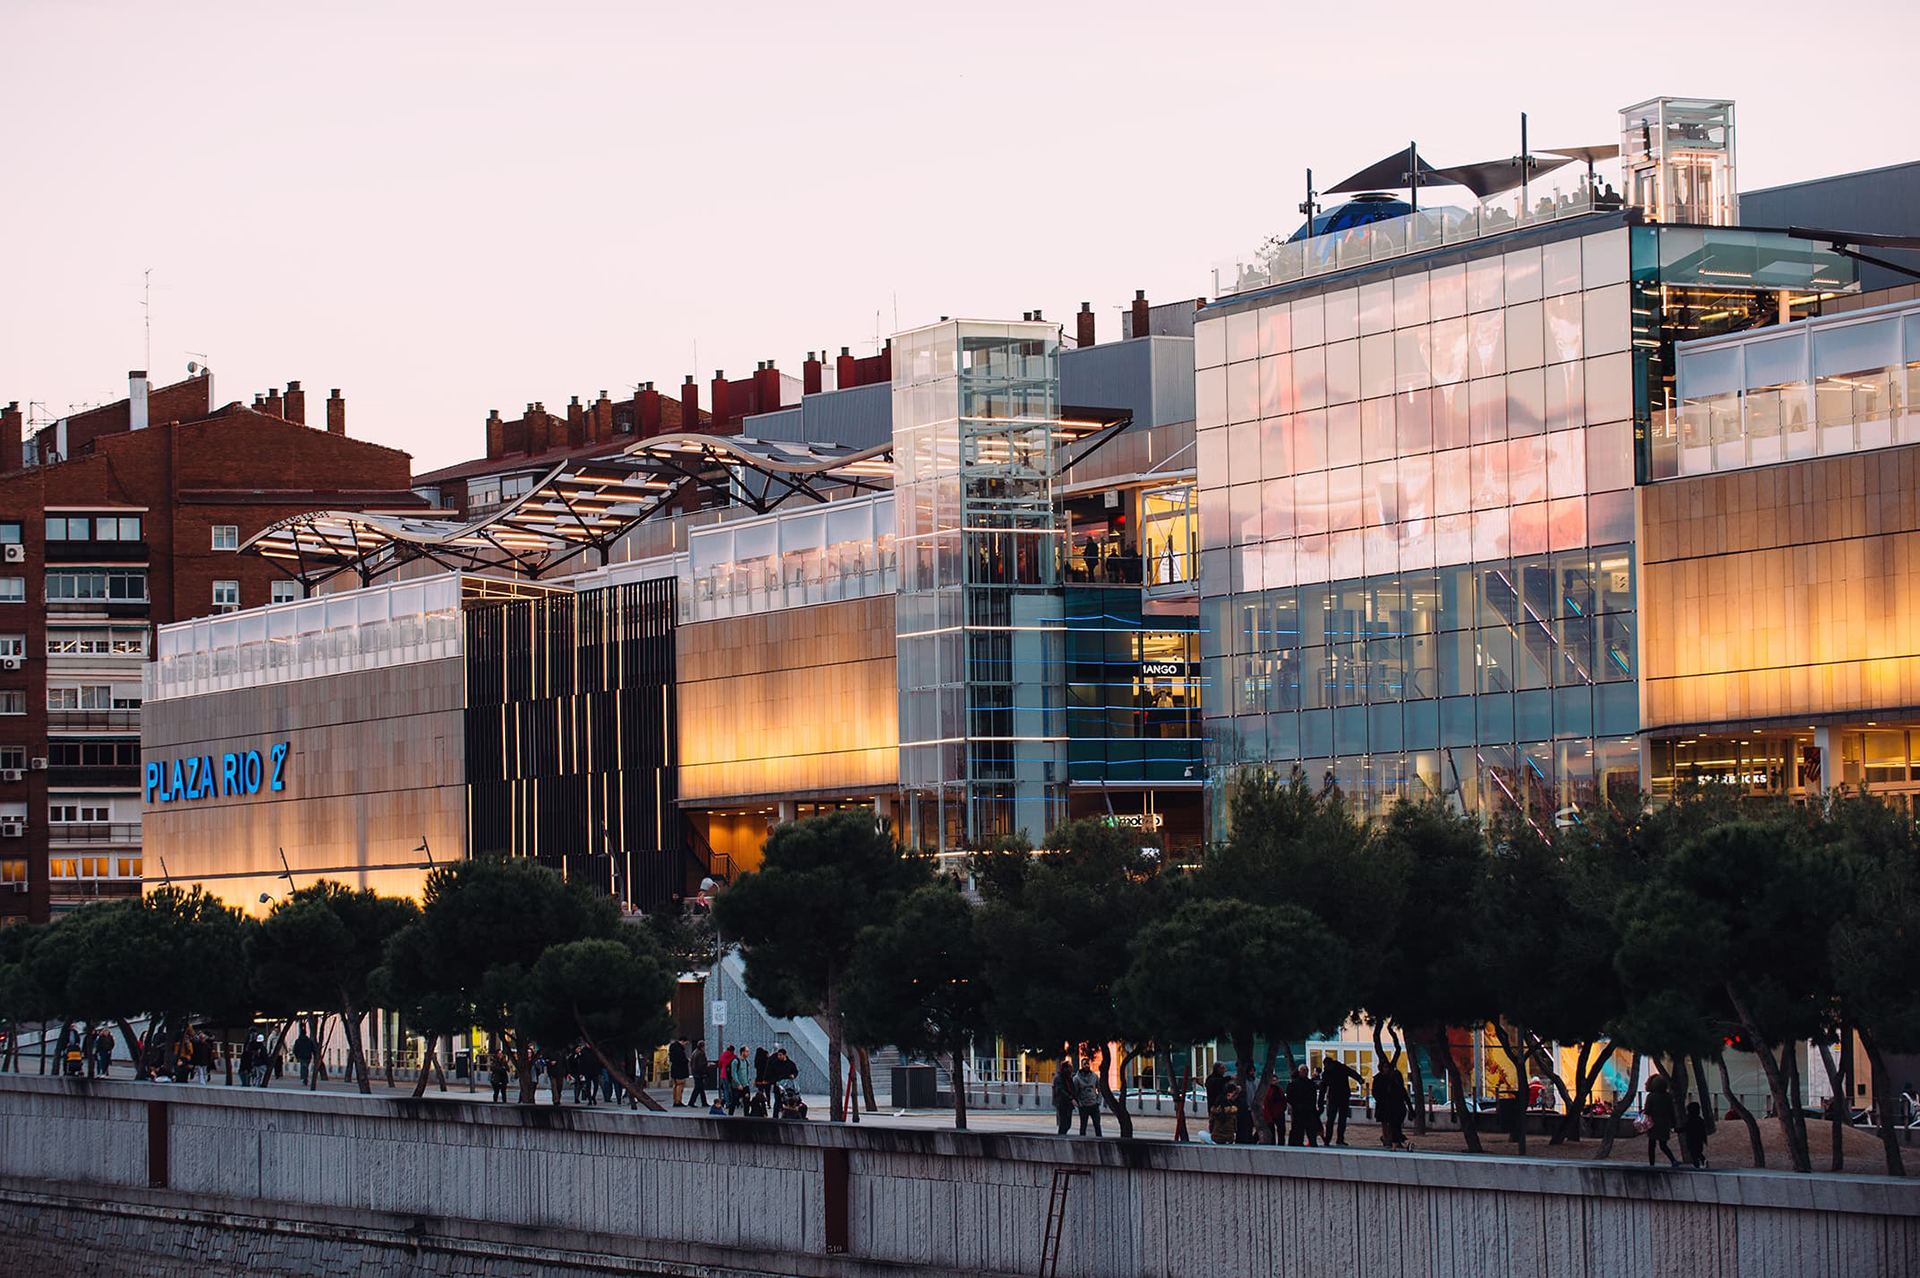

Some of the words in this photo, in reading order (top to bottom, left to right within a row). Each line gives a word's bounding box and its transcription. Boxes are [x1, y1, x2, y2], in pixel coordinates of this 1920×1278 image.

[146, 755, 217, 803] PLAZA
[223, 748, 263, 796] RIO
[270, 741, 290, 792] 2
